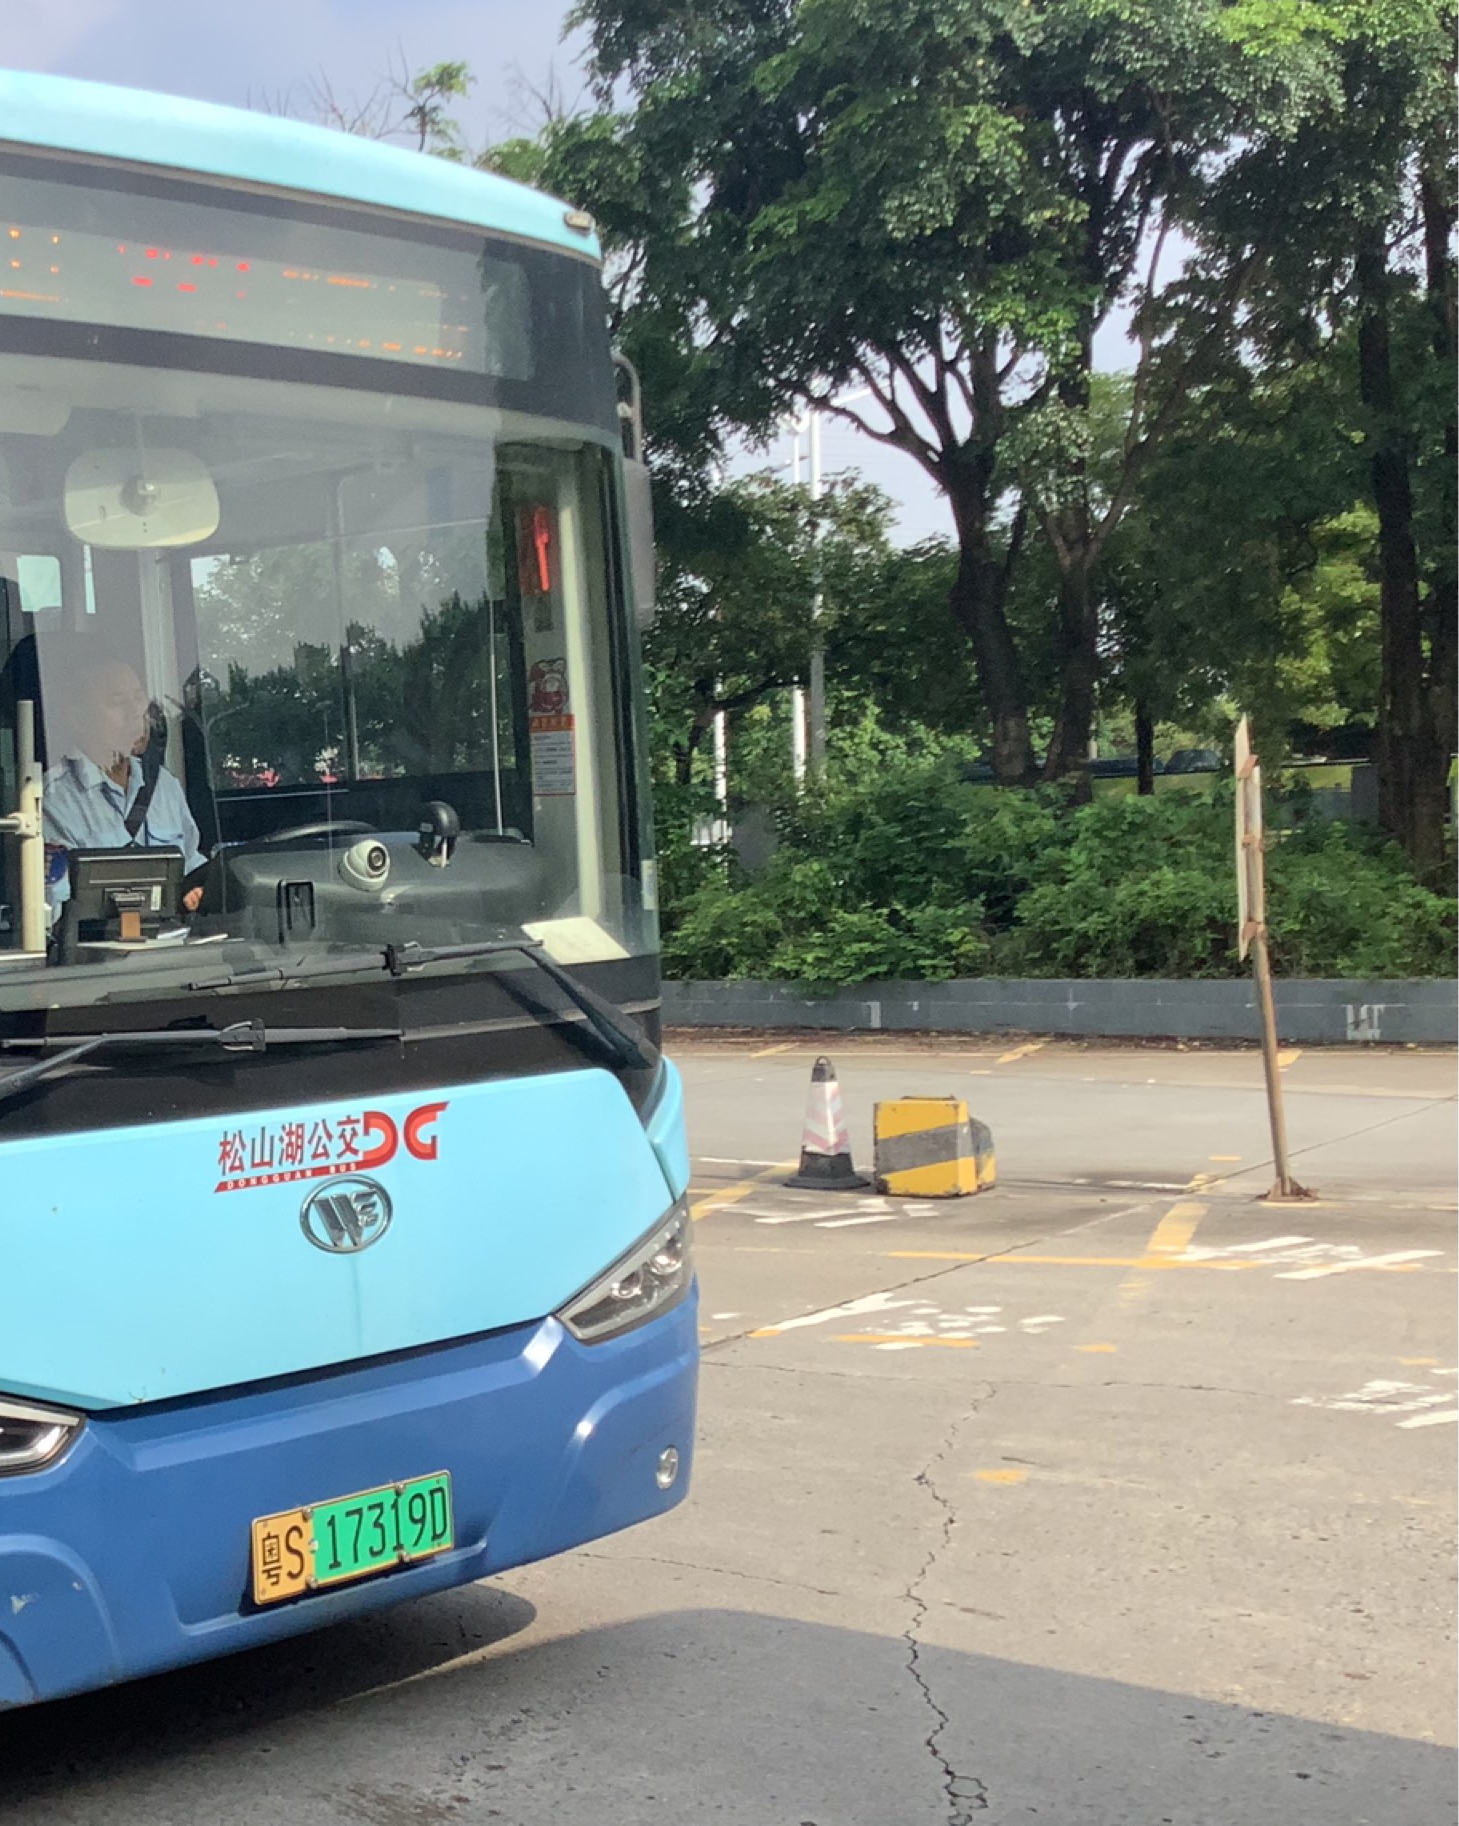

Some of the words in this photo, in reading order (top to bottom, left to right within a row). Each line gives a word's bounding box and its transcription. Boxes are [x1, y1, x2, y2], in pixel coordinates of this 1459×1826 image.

[218, 1115, 360, 1176] 松山湖公交
[227, 1169, 312, 1190] DONGGUAN
[329, 1162, 357, 1174] BUS
